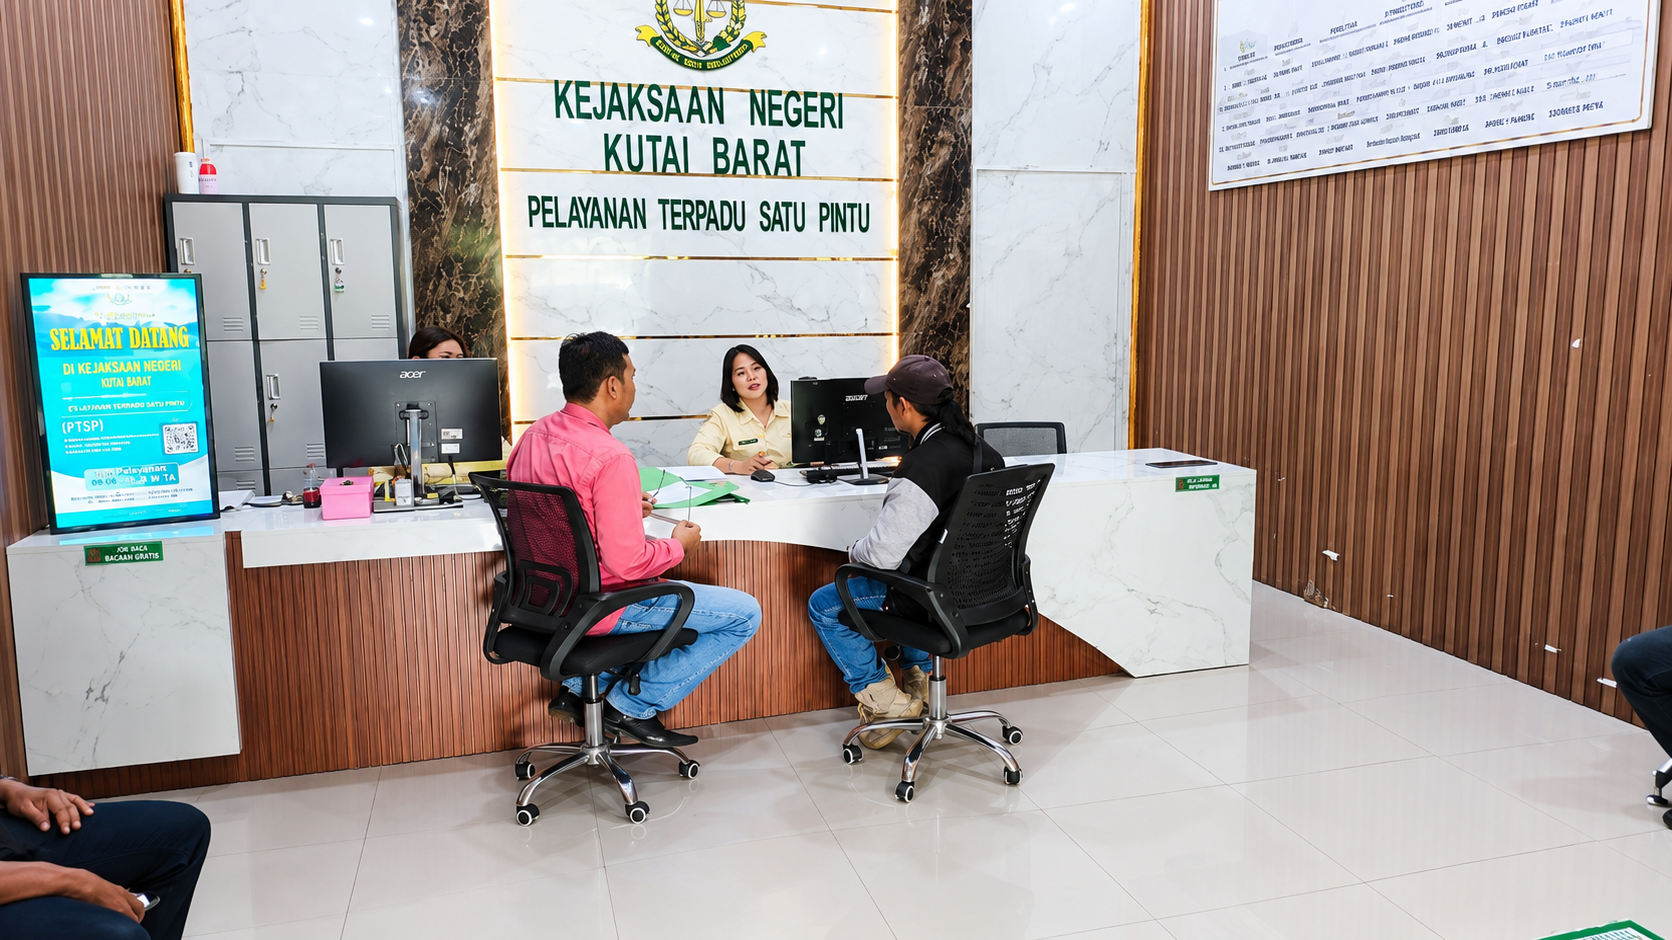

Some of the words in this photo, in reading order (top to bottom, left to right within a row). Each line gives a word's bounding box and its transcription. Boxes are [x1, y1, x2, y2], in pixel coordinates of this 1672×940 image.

[554, 79, 724, 125] KEJAKSAAN
[749, 88, 844, 129] NEGERI
[603, 133, 689, 173] KUTAI
[712, 137, 806, 177] BARAT
[527, 195, 647, 230] PELAYANAN
[658, 198, 746, 231] TERPADU
[759, 200, 806, 232] SATU
[819, 202, 870, 233] PINTU
[50, 327, 124, 351] SELAMAT
[128, 326, 190, 349] DATANG
[63, 363, 75, 376] DI
[78, 361, 141, 375] KEJAKSAAN
[399, 370, 426, 379] acer
[61, 418, 104, 435] (PTSP)
